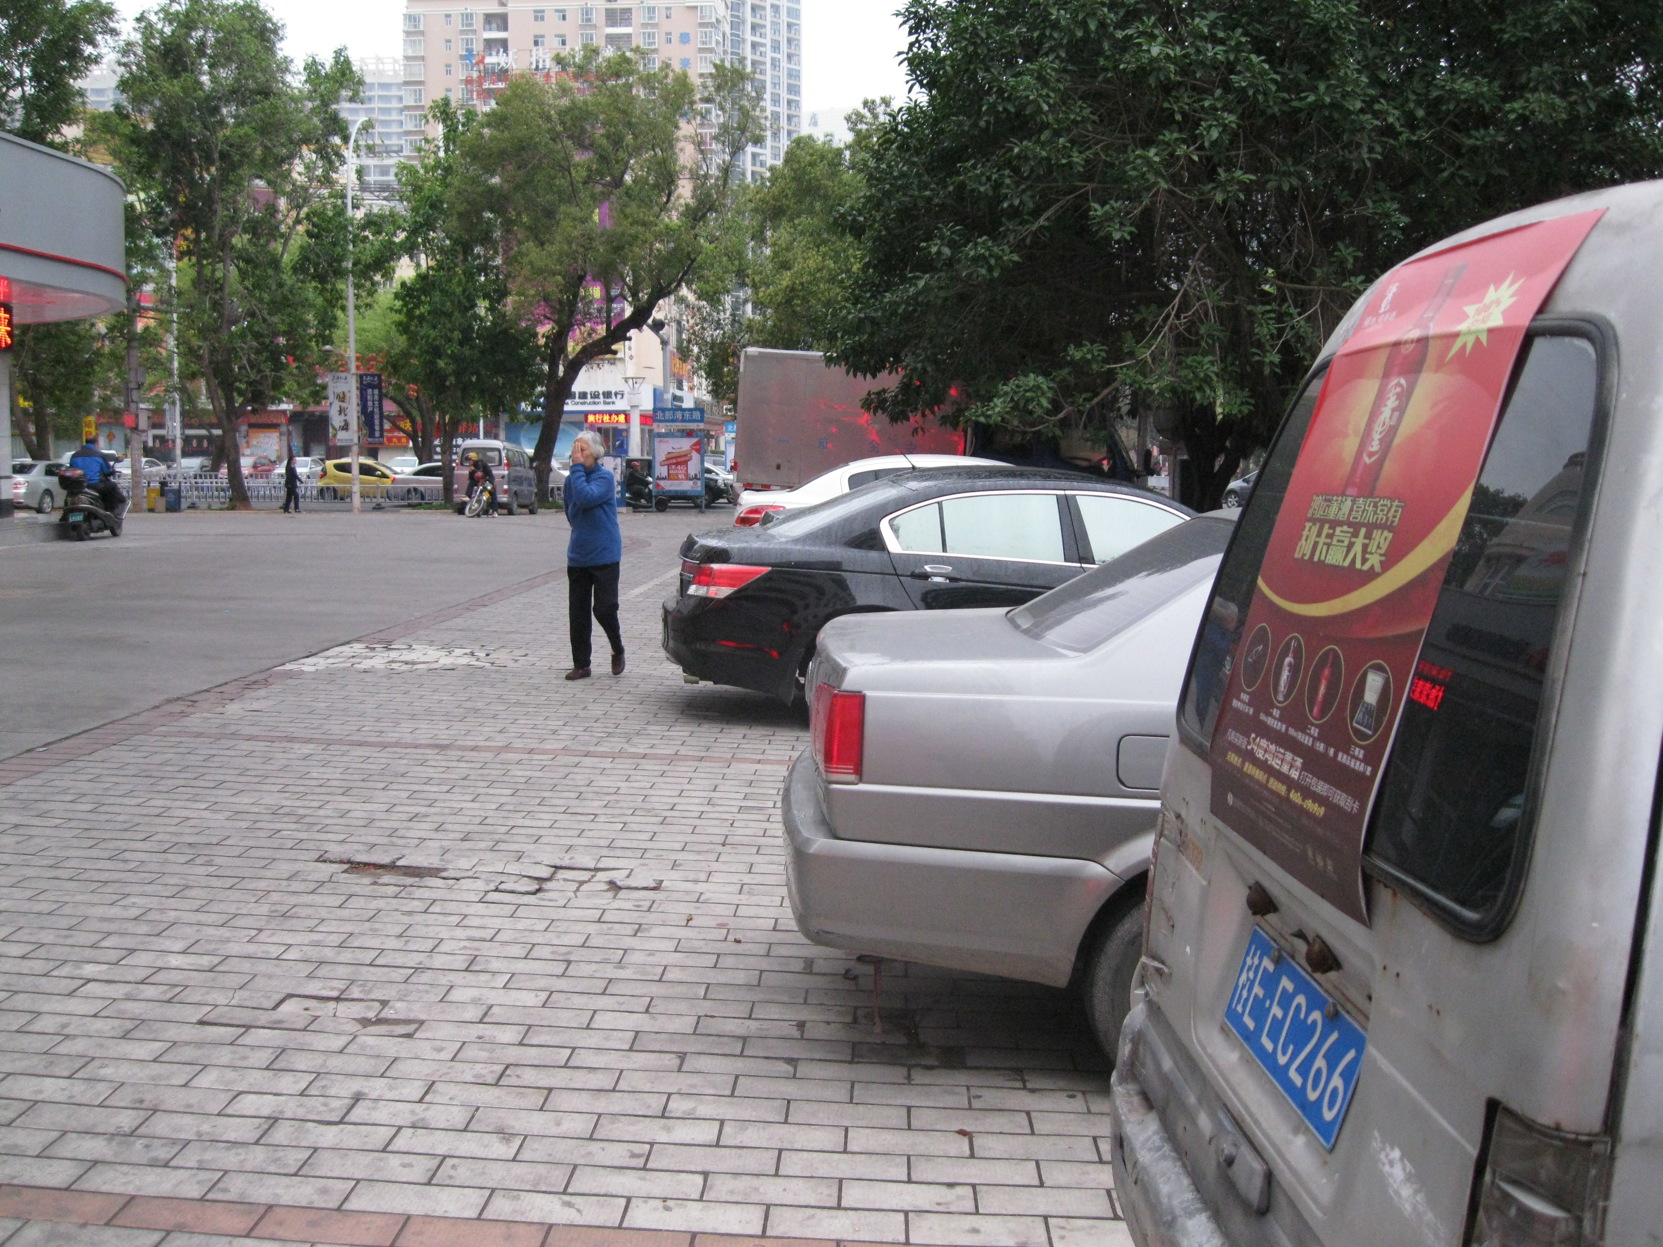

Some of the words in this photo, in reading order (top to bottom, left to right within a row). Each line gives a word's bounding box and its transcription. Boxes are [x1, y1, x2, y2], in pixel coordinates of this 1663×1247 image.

[655, 410, 702, 421] 北部湾东路
[1349, 496, 1405, 527] 喜乐常有
[1294, 522, 1393, 573] 刮卡赢大奖
